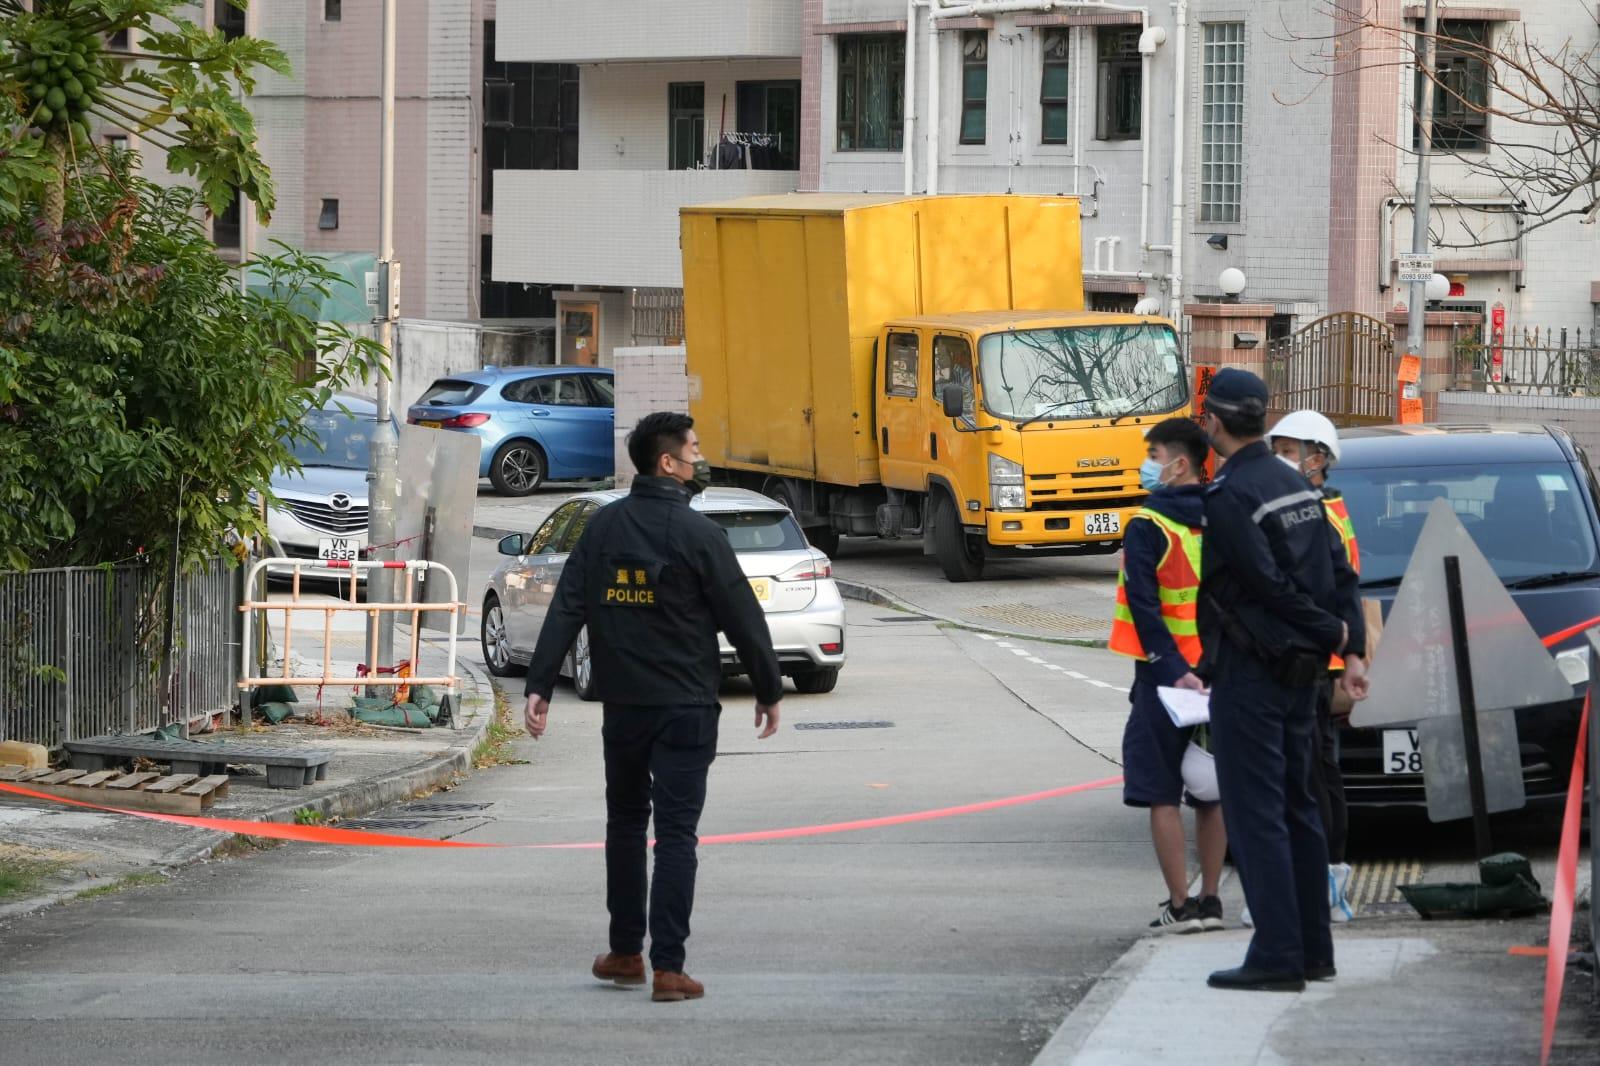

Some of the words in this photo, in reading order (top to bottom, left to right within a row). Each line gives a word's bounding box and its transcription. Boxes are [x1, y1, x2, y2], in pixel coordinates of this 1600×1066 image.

[1077, 457, 1120, 468] ISUZU
[1094, 513, 1110, 524] RB
[1086, 522, 1119, 534] 9443
[331, 538, 348, 549] VN
[322, 549, 356, 560] 4632
[606, 588, 655, 603] POLICE
[1407, 731, 1420, 751] V
[1391, 751, 1422, 772] 58
